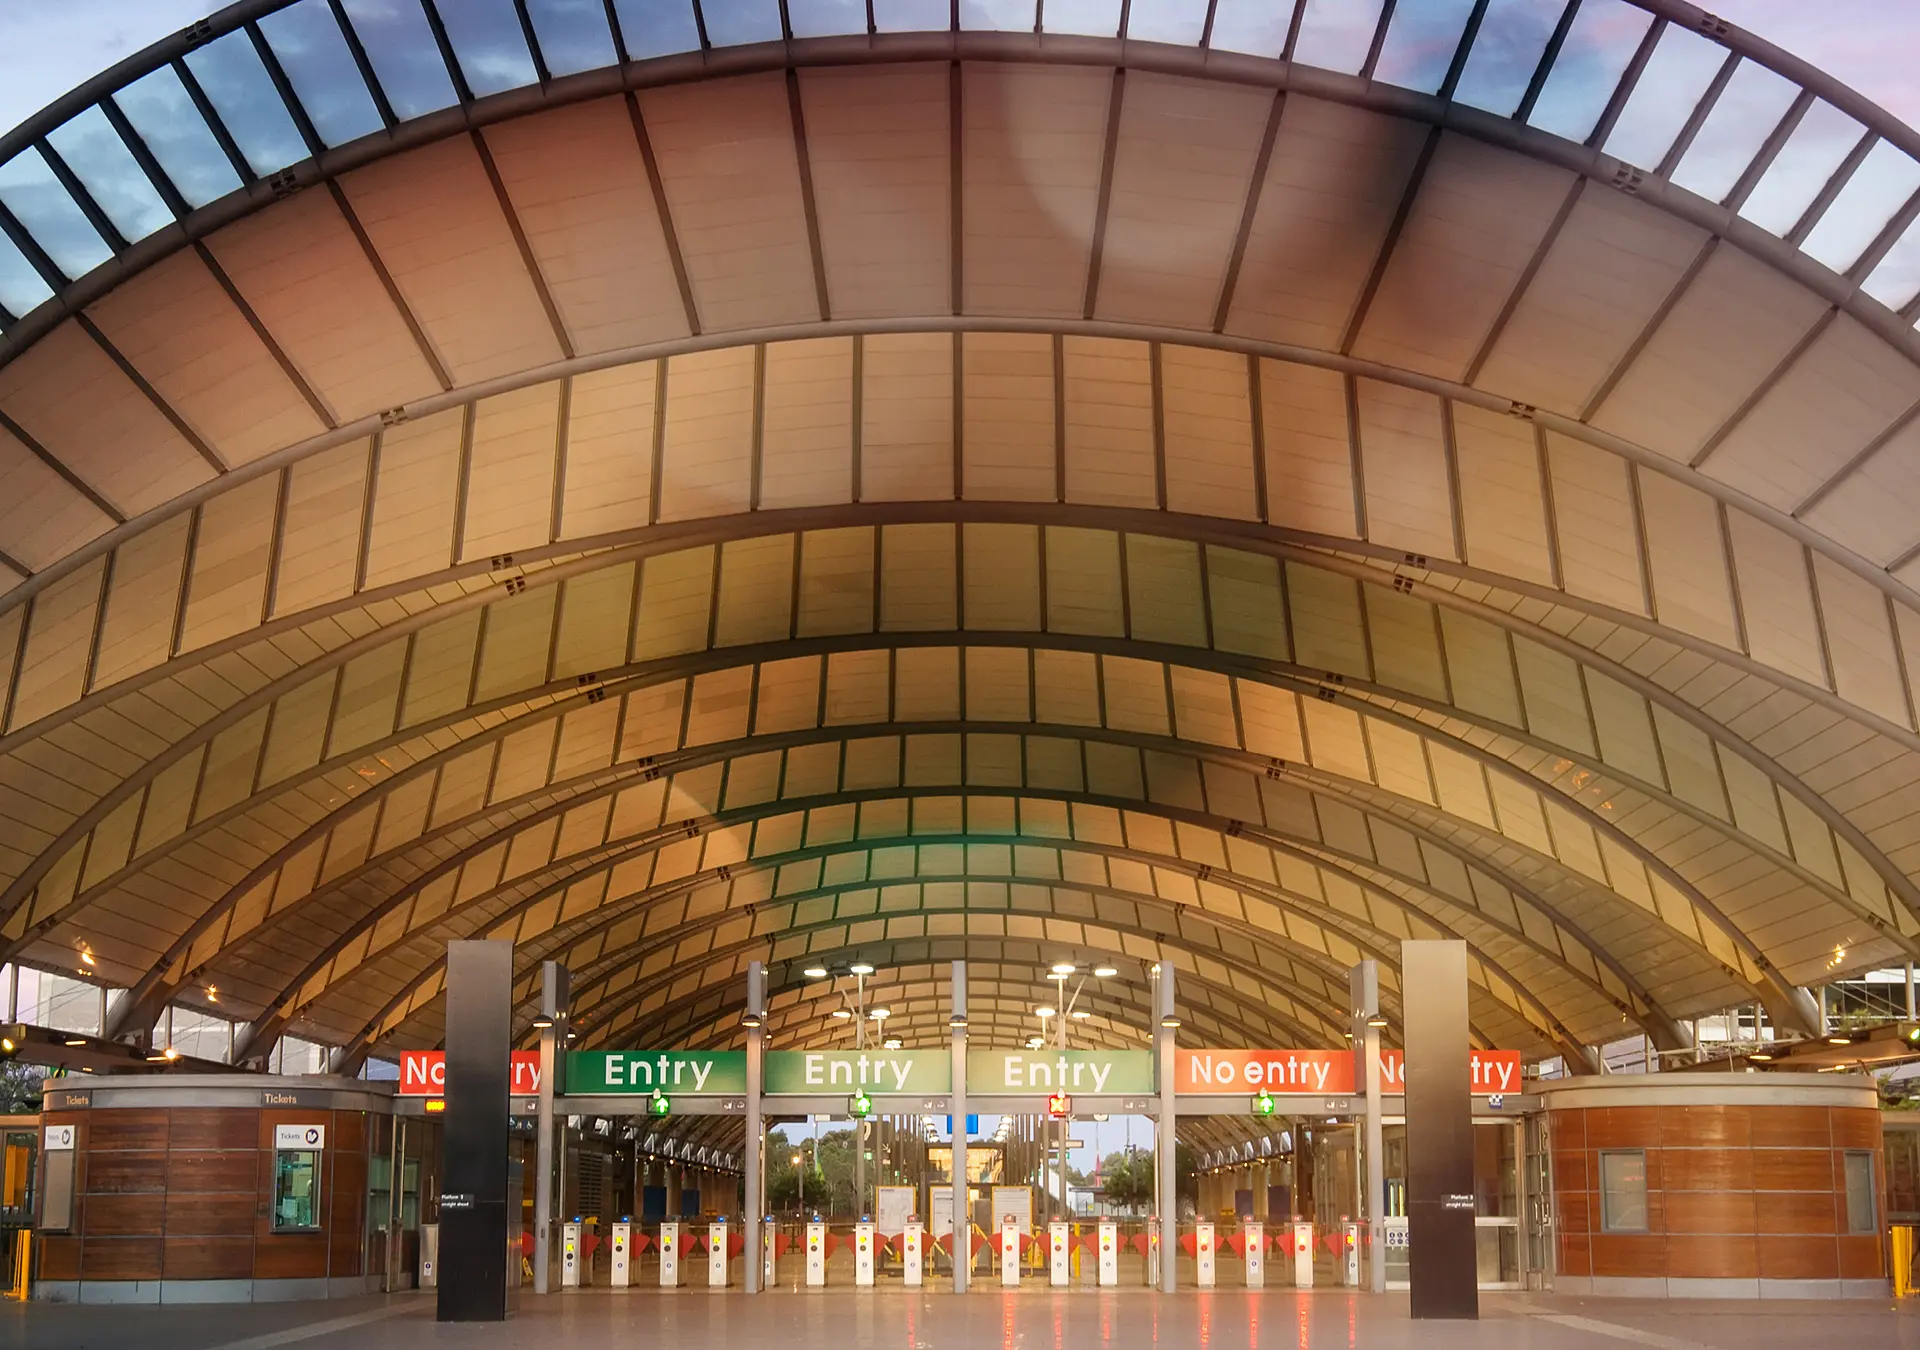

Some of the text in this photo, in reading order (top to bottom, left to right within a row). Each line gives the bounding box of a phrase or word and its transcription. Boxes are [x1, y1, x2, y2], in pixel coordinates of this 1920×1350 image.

[605, 1054, 713, 1092] Entry
[805, 1054, 913, 1091] Entry
[1004, 1056, 1112, 1093] Entry
[1191, 1055, 1331, 1090] No entry
[264, 1093, 297, 1104] Tickets
[281, 1132, 300, 1140] Tickets
